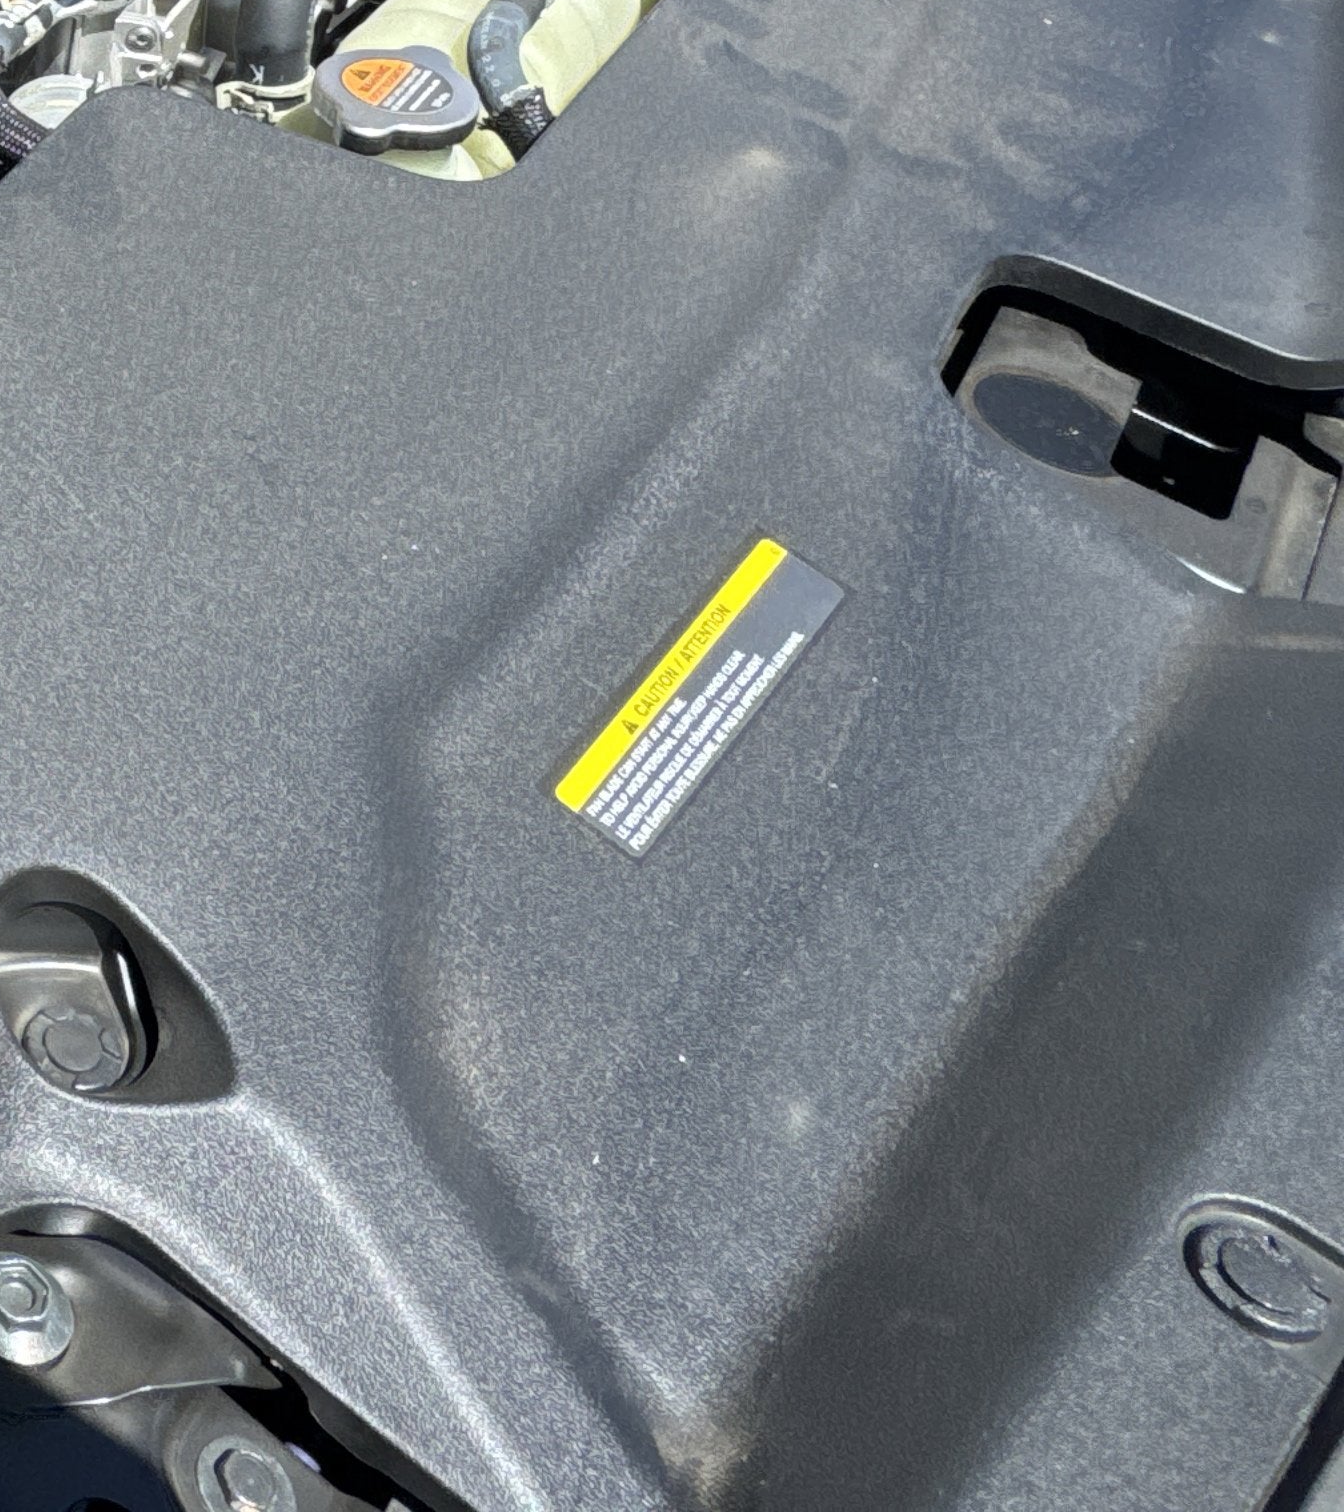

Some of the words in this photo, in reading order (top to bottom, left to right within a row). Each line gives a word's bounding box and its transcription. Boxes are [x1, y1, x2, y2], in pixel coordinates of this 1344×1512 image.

[632, 665, 680, 718] CAUTION
[676, 602, 731, 663] ATTENTION
[597, 772, 624, 802] BLADE
[616, 757, 637, 779] CAN
[629, 736, 654, 763] START
[653, 712, 673, 732] ANY
[598, 810, 616, 828] TO
[607, 791, 631, 817] HELP
[622, 769, 649, 798] AVOID
[640, 733, 678, 776] PERSONAL
[700, 670, 728, 699] HANDS
[627, 821, 654, 851] POUR
[718, 713, 739, 733] PAS
[613, 822, 631, 840] LE
